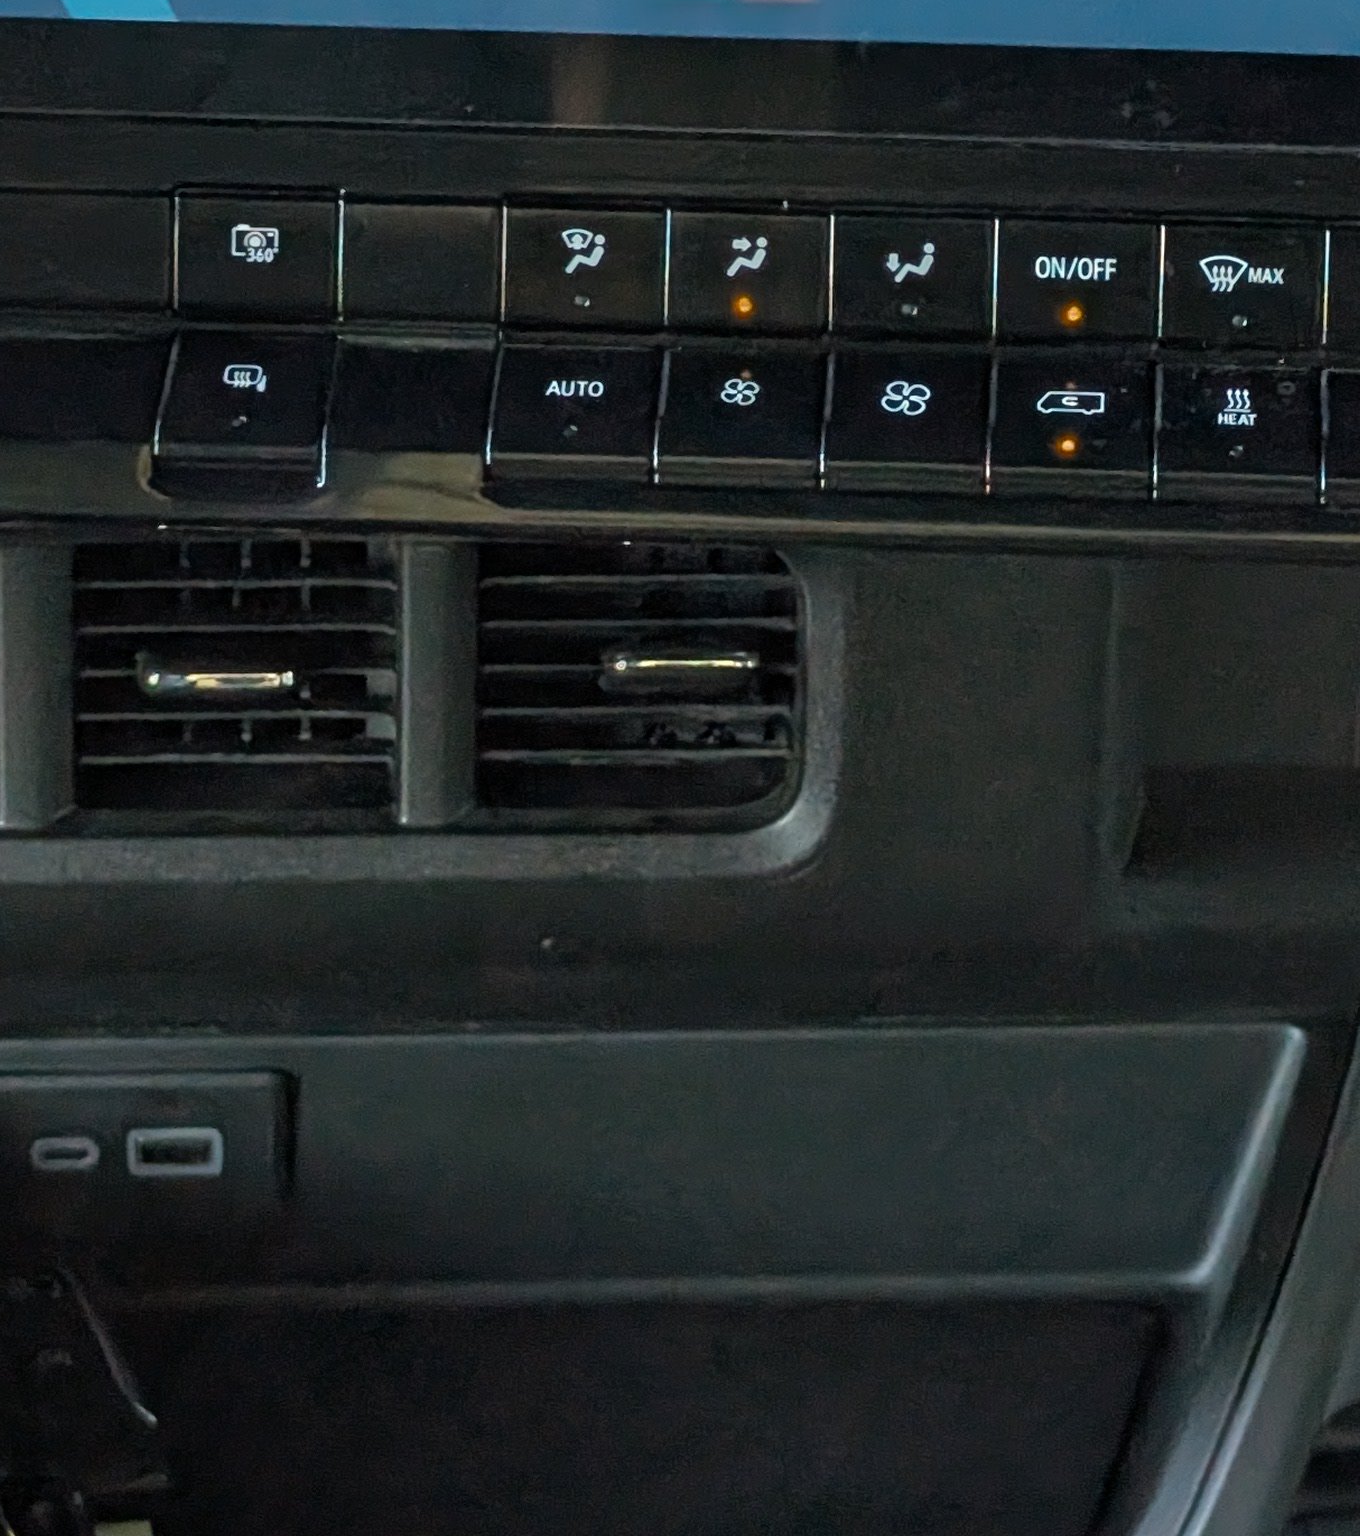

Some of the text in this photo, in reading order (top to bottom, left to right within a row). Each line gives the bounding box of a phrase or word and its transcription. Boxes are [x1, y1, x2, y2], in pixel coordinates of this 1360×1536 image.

[246, 247, 279, 263] 360°
[1034, 255, 1119, 282] ON/OFF
[1247, 267, 1285, 285] MAX
[545, 380, 605, 399] AUTO
[1217, 412, 1258, 427] HEAT
